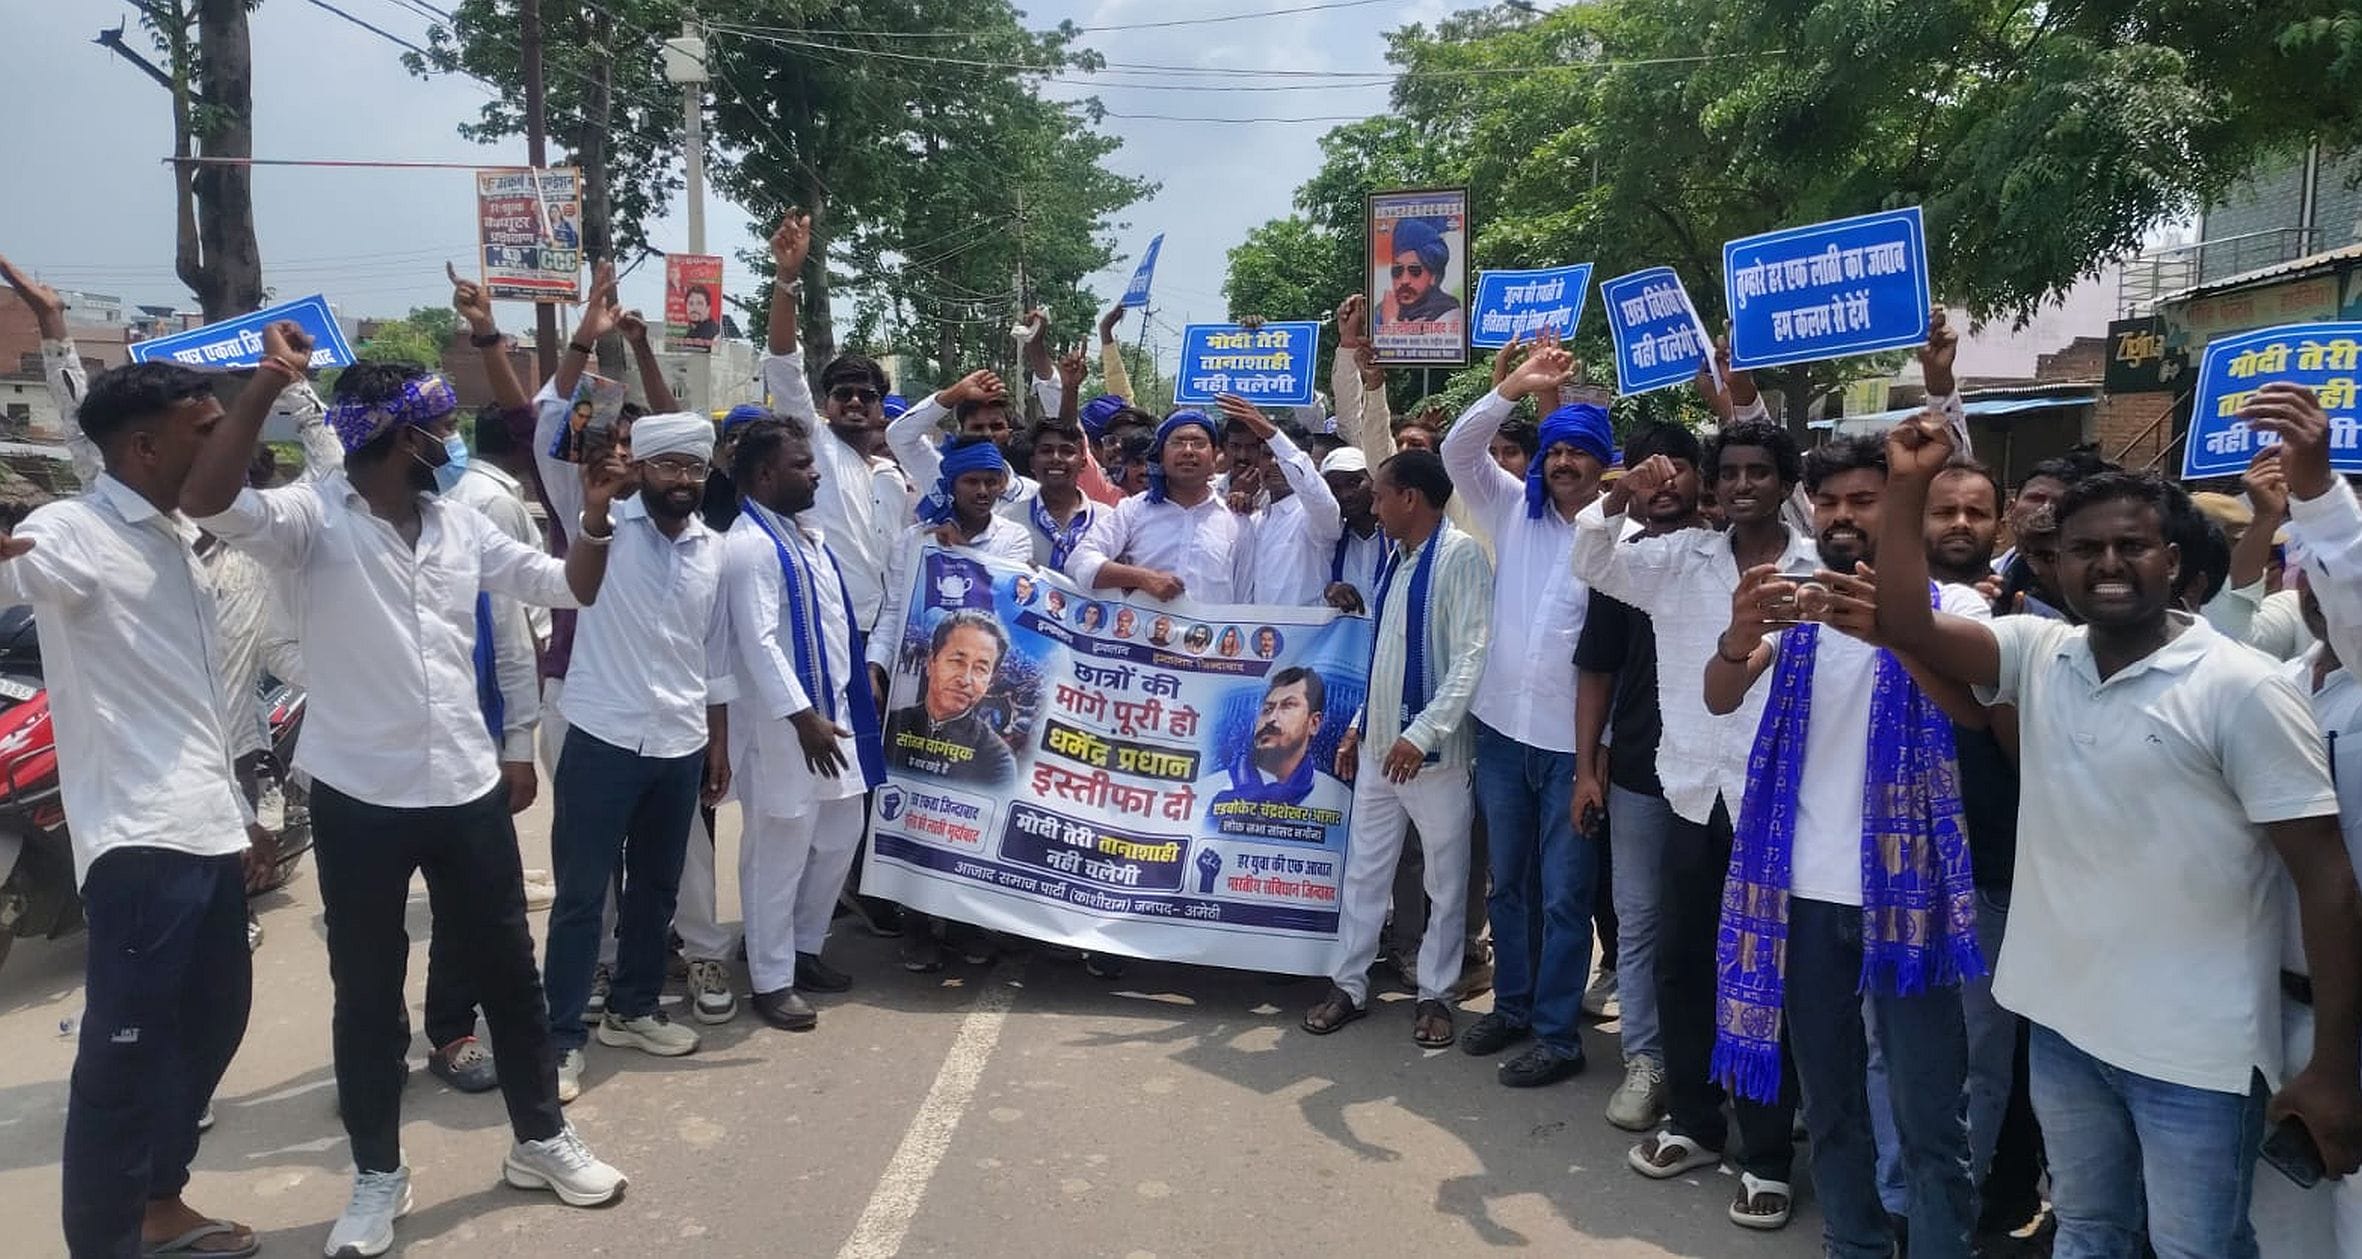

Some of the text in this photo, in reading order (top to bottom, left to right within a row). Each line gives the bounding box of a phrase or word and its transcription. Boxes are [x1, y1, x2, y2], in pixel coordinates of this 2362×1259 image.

[541, 250, 576, 271] CCC
[1736, 241, 1906, 309] तुम्हारे हर एक लाठी का जवाब
[1772, 310, 1794, 341] हम
[1793, 305, 1832, 339] कलम
[1832, 294, 1846, 333] से
[1206, 330, 1292, 350] मोदी तेरी
[2228, 339, 2362, 379] मोदी तेरी
[1200, 352, 1293, 372] तानाशाही
[1234, 374, 1296, 393] चलेगी
[2205, 422, 2252, 455] नही
[1074, 660, 1182, 699] छात्रों की
[1054, 683, 1201, 738] मांगे पूरी हो
[1118, 746, 1196, 779] प्रधान
[1032, 760, 1198, 822] इस्तीफा दो
[1016, 810, 1181, 863] मोदी तेरी तानाशाही
[954, 861, 997, 882] आजाद
[999, 871, 1037, 892] समाज
[1040, 880, 1068, 899] पार्टी
[1069, 888, 1131, 912] (काशीराम)
[1184, 901, 1221, 921] अमेठी
[1084, 857, 1142, 886] चलेगी
